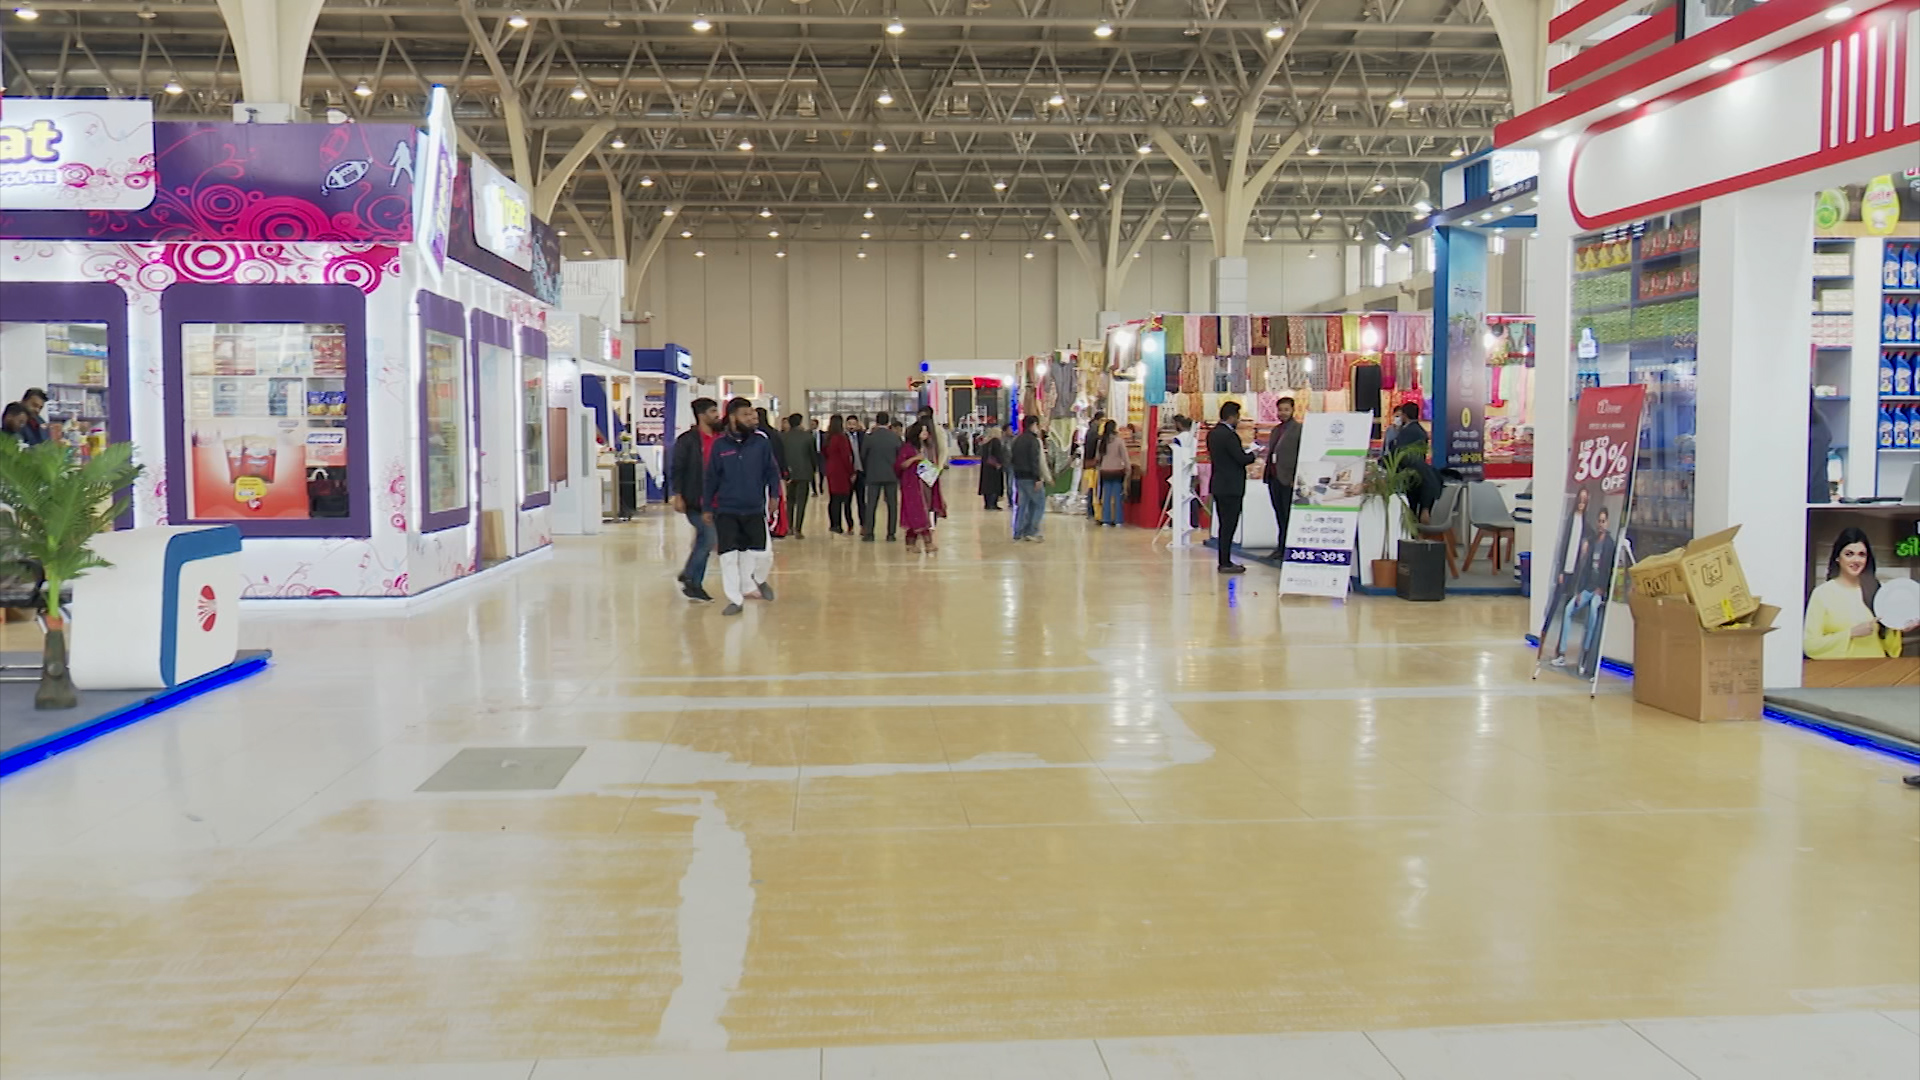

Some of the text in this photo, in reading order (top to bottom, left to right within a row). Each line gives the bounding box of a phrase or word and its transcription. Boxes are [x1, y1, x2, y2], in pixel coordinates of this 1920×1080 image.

[1580, 435, 1610, 451] UP TO
[1574, 441, 1628, 481] 30%
[1601, 473, 1627, 490] OFF
